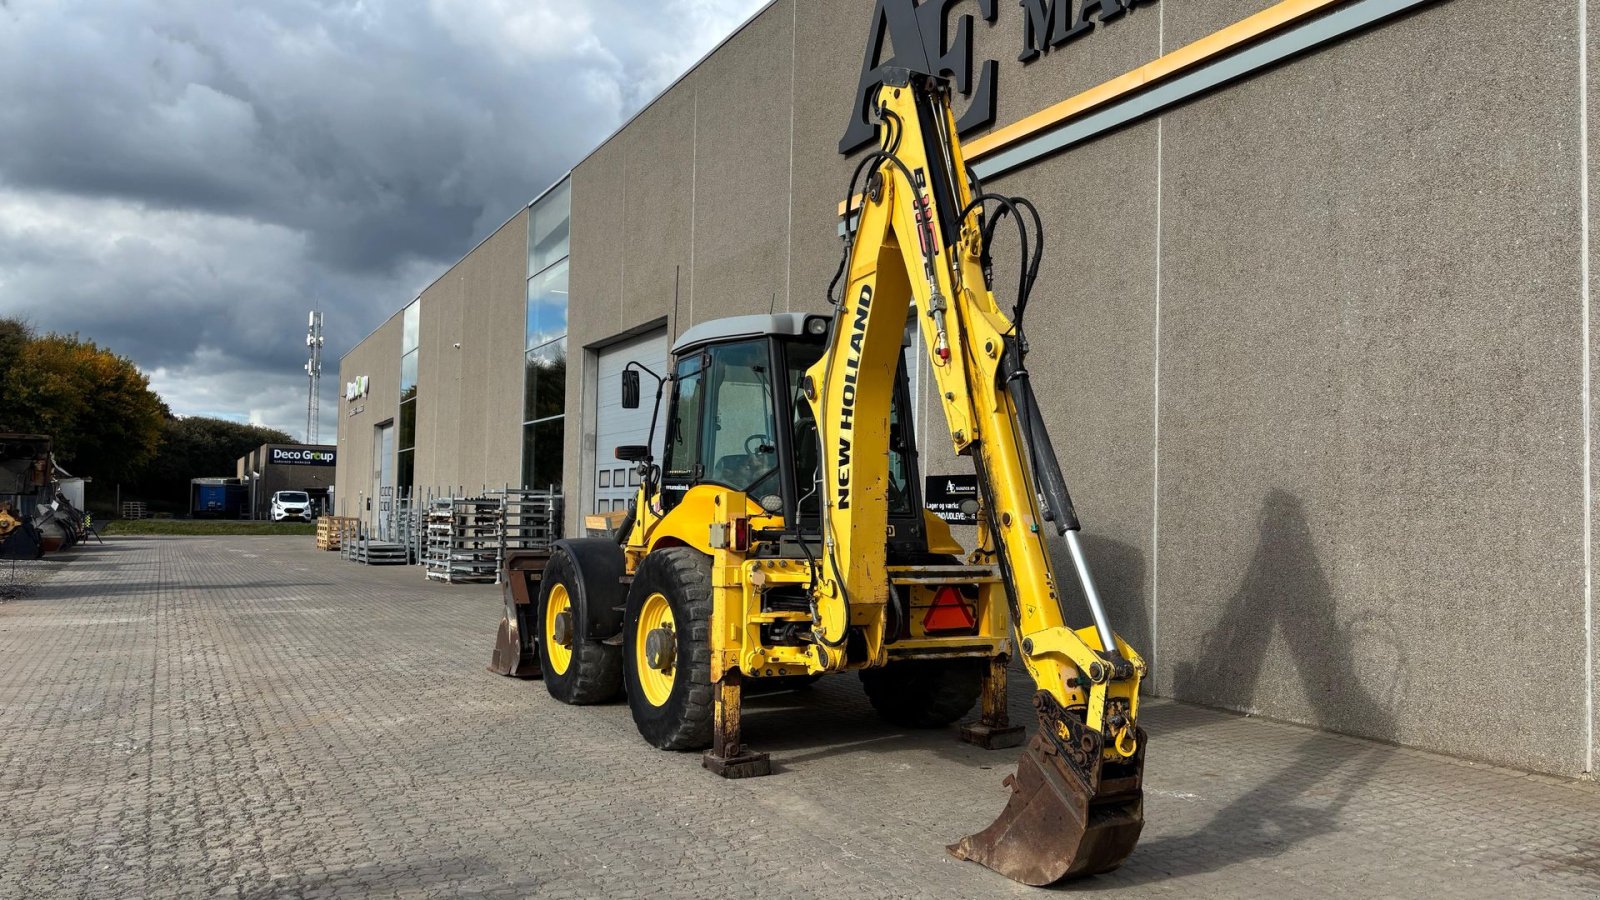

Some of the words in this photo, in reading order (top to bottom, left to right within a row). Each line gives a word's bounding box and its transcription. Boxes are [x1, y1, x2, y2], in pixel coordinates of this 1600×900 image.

[913, 167, 940, 278] B115
[840, 284, 873, 431] HOLLAND
[273, 449, 301, 459] Deco
[302, 450, 335, 463] Group
[838, 437, 851, 510] NEW
[926, 502, 939, 510] Lager
